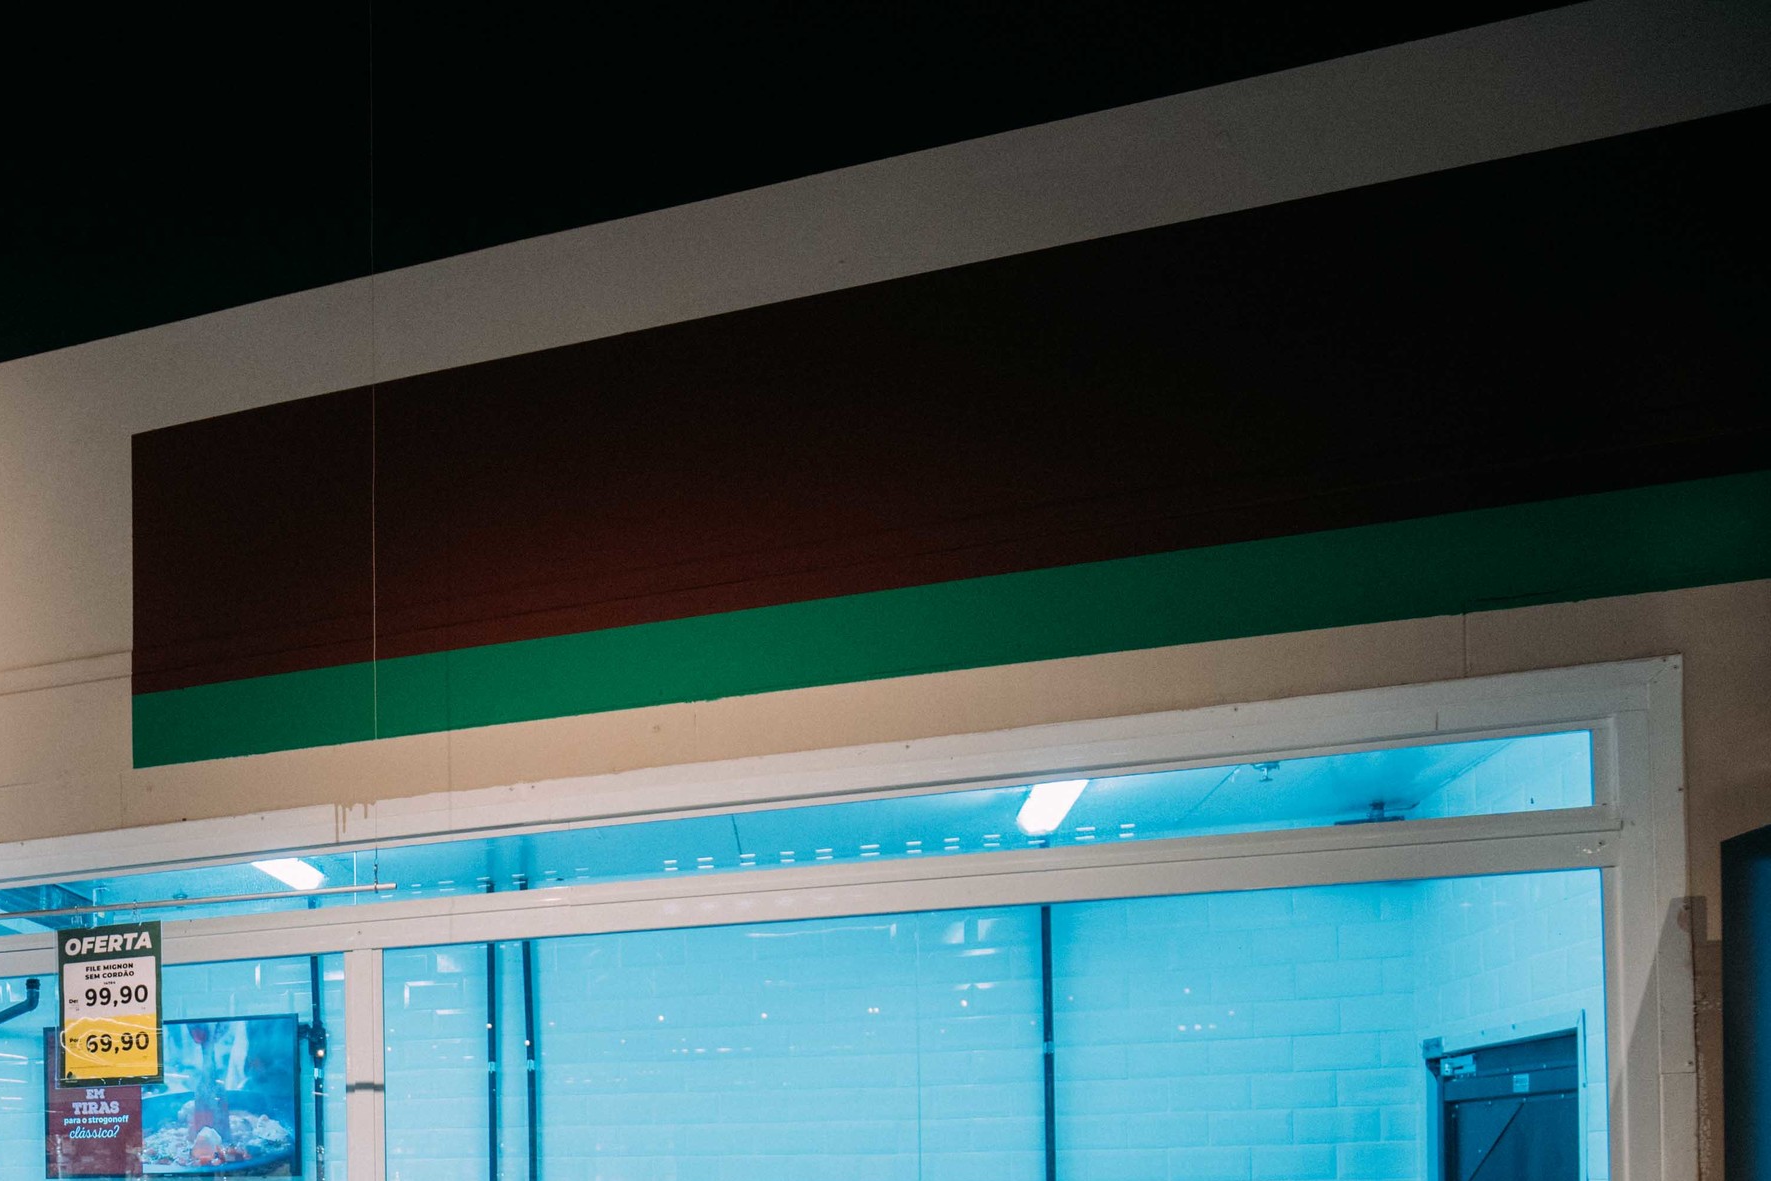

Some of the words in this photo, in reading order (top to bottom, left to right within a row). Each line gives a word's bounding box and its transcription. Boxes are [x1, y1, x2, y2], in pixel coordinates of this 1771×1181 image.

[65, 931, 152, 956] OFERTA
[103, 962, 134, 971] MIGNON
[85, 972, 100, 980] SEM
[102, 970, 134, 979] CORDÃO
[85, 984, 148, 1007] 99,90
[86, 1031, 149, 1053] 69,90
[86, 1089, 105, 1099] EM
[72, 1101, 120, 1115] TIRAS
[64, 1117, 81, 1126] para
[88, 1115, 129, 1125] strogonoff
[69, 1125, 120, 1139] clássico?
